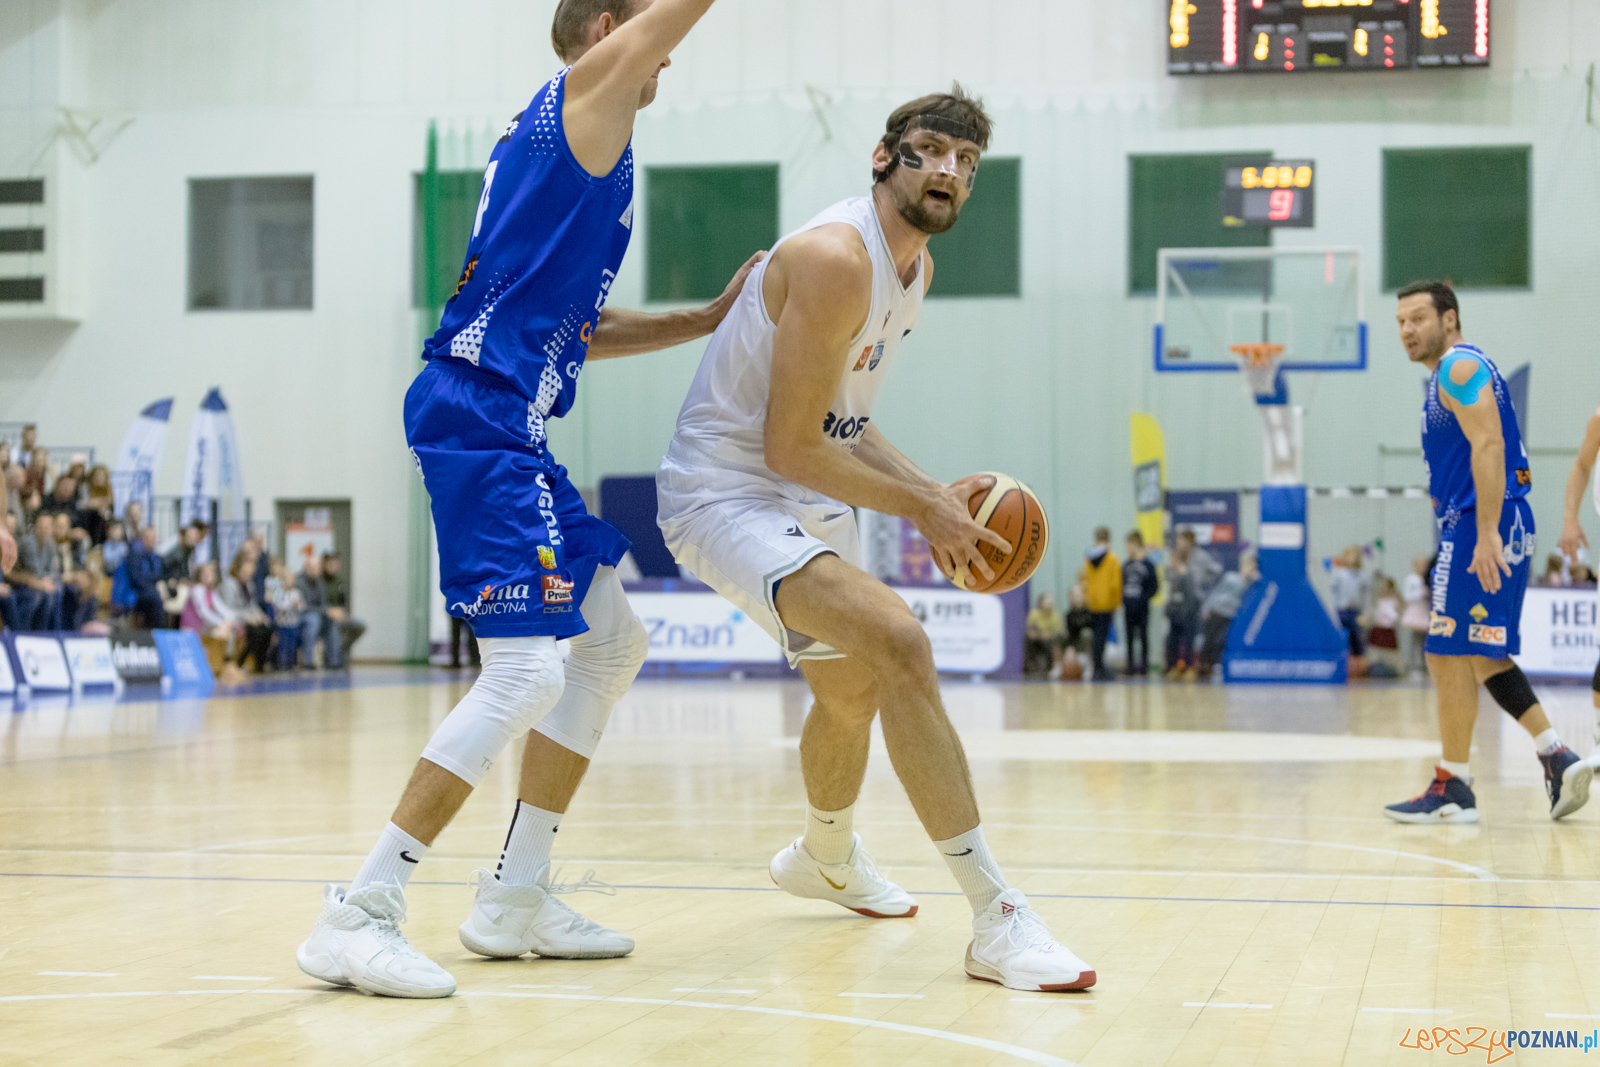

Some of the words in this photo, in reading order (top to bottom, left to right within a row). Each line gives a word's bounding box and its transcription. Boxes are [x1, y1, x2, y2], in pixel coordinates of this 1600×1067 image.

[1268, 189, 1294, 220] 9
[822, 411, 870, 439] BIOF
[1432, 541, 1455, 614] PRUDNIK
